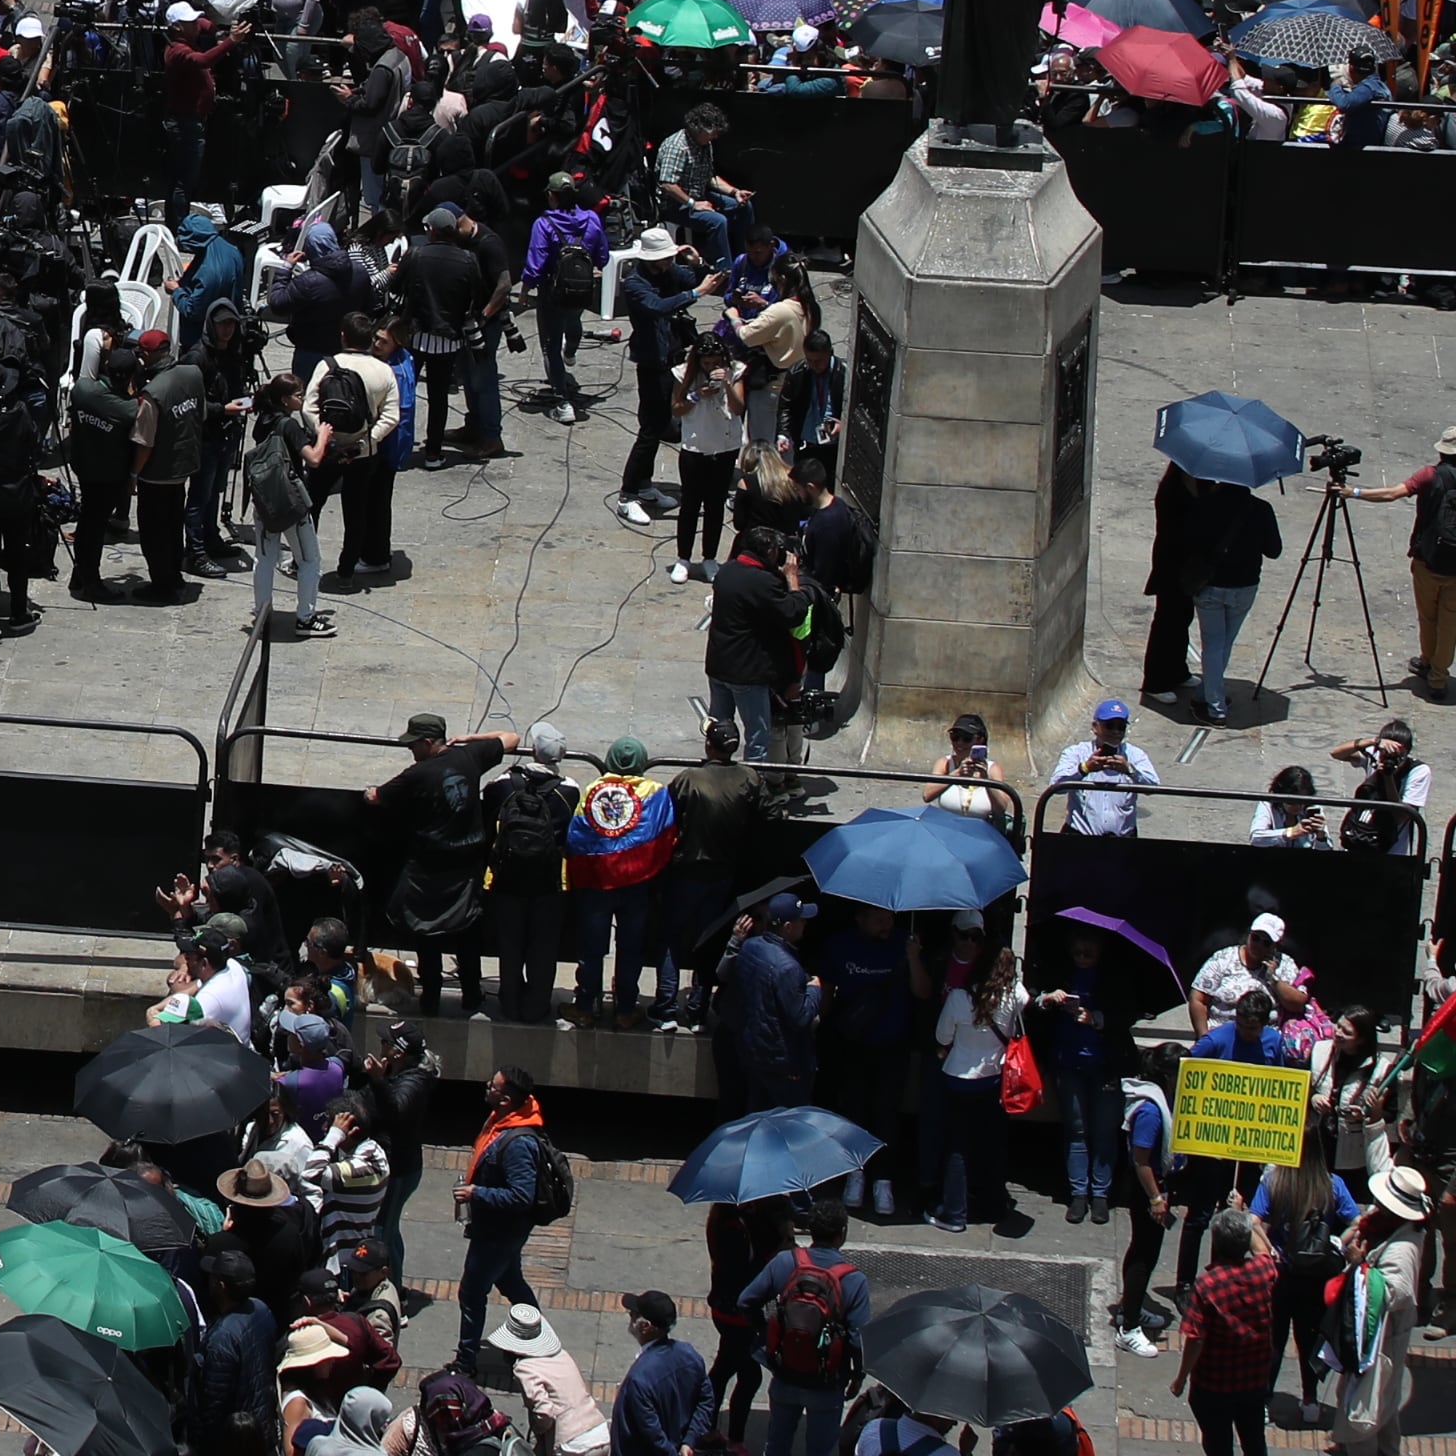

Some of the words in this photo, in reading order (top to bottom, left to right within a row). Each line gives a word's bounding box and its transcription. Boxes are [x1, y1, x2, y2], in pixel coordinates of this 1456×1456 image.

[77, 410, 114, 433] Prensa
[1185, 1070, 1208, 1090] SOY
[1211, 1071, 1302, 1102] SOBREVIVIENTE
[1180, 1095, 1198, 1116] DEL
[1201, 1097, 1256, 1122] GENOCIDIO
[1258, 1103, 1299, 1127] CONTRA
[1177, 1120, 1191, 1141] LA
[1195, 1119, 1231, 1145] UNIÓN
[1233, 1126, 1296, 1153] PATRIÓTICA
[96, 1326, 123, 1338] oppo
